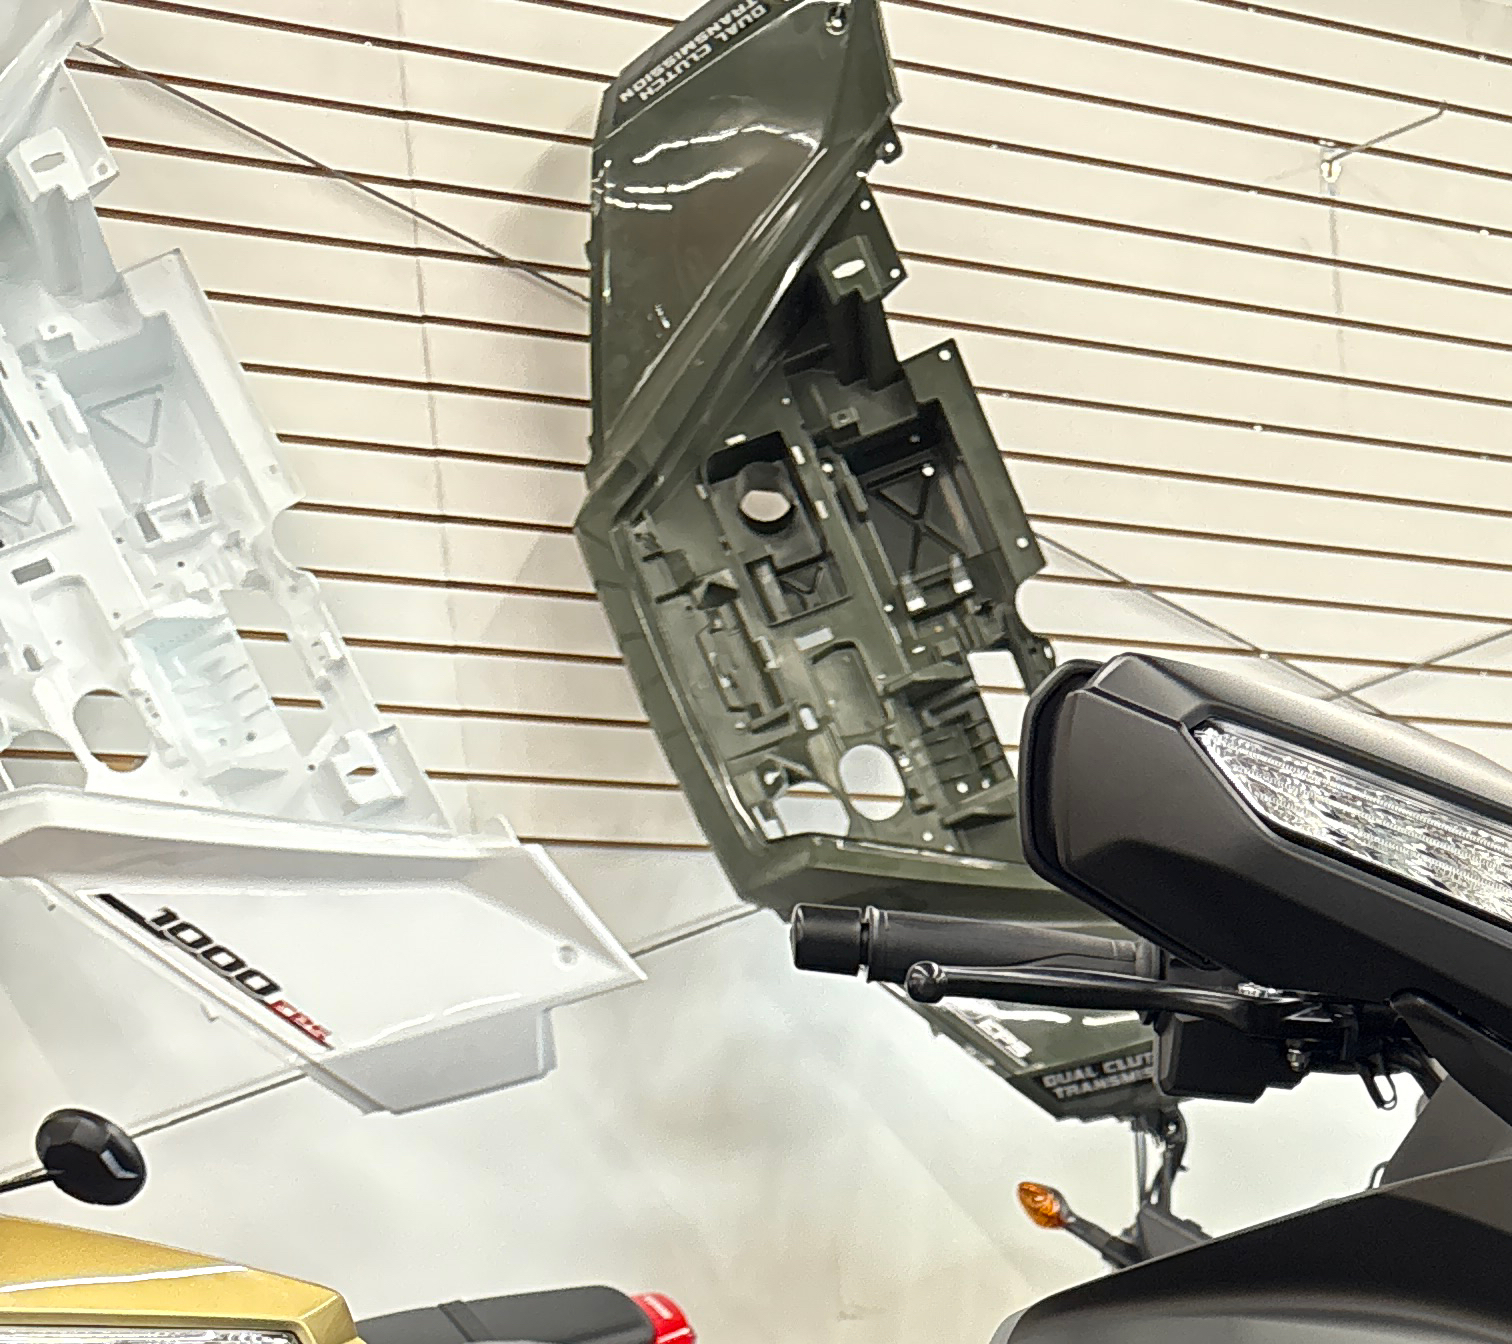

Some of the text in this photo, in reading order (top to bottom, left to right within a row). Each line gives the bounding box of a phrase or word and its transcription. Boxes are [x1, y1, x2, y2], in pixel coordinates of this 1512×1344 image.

[638, 3, 768, 102] DUAL CLUTCH
[149, 905, 283, 998] 1000
[1042, 1051, 1154, 1088] DUAL CLUT
[1052, 1066, 1154, 1099] TRANSMIS
